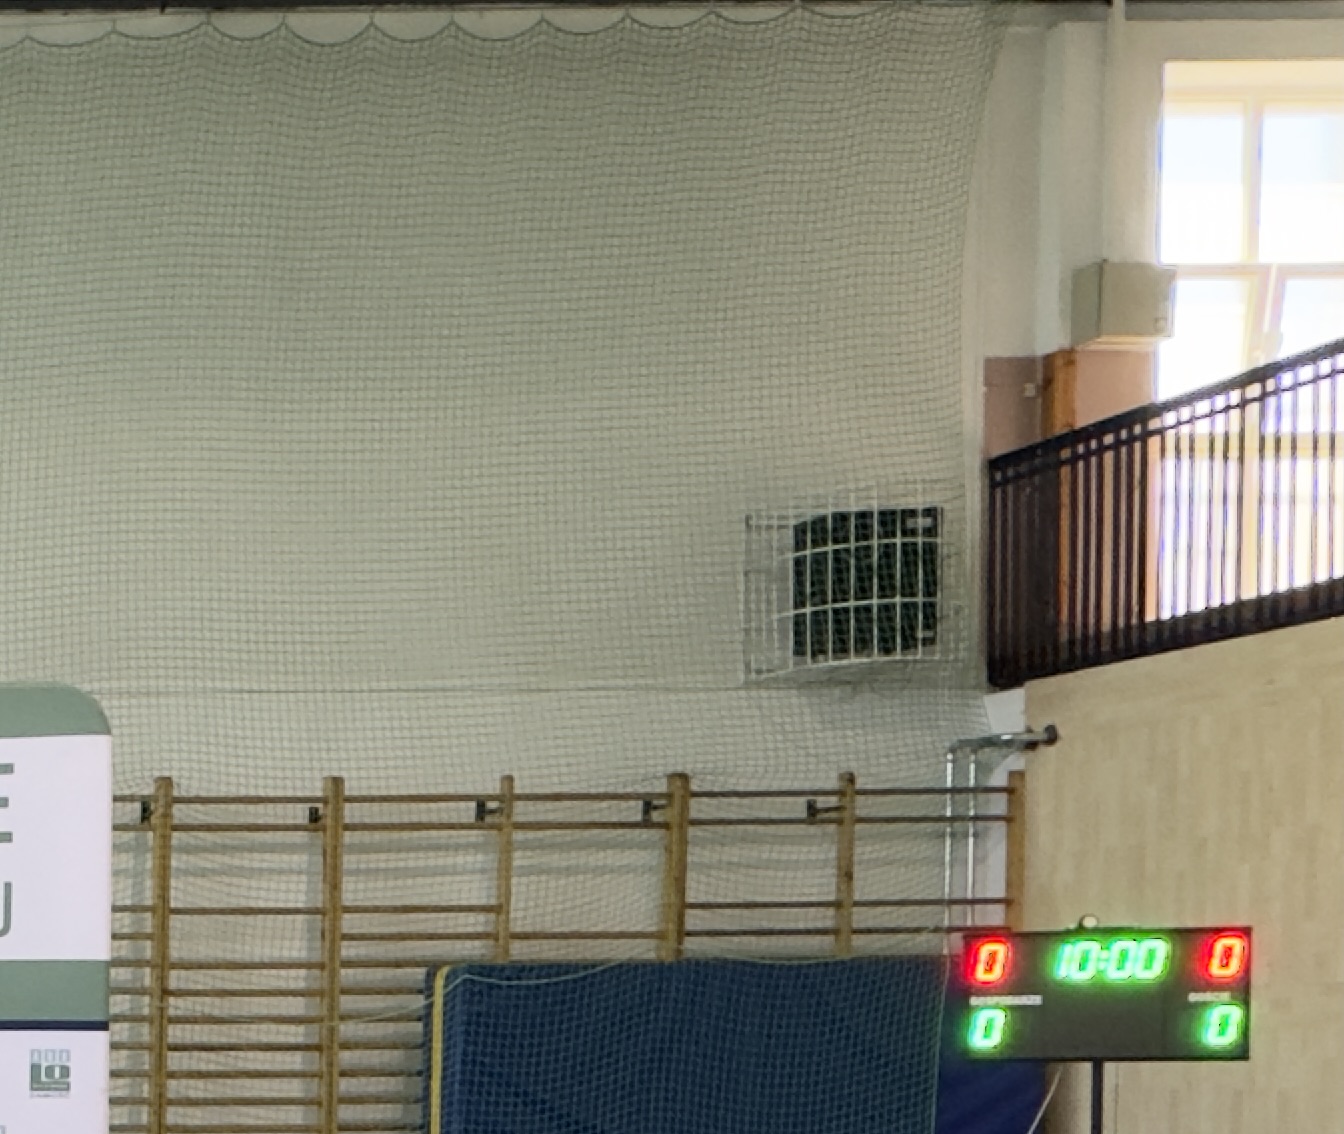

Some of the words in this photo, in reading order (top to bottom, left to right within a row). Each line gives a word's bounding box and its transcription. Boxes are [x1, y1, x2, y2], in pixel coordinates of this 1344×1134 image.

[974, 941, 1009, 984] 0
[1054, 937, 1172, 982] 10:00
[1208, 933, 1247, 980] 0
[968, 1007, 1007, 1049] 0
[1201, 1003, 1244, 1047] 0
